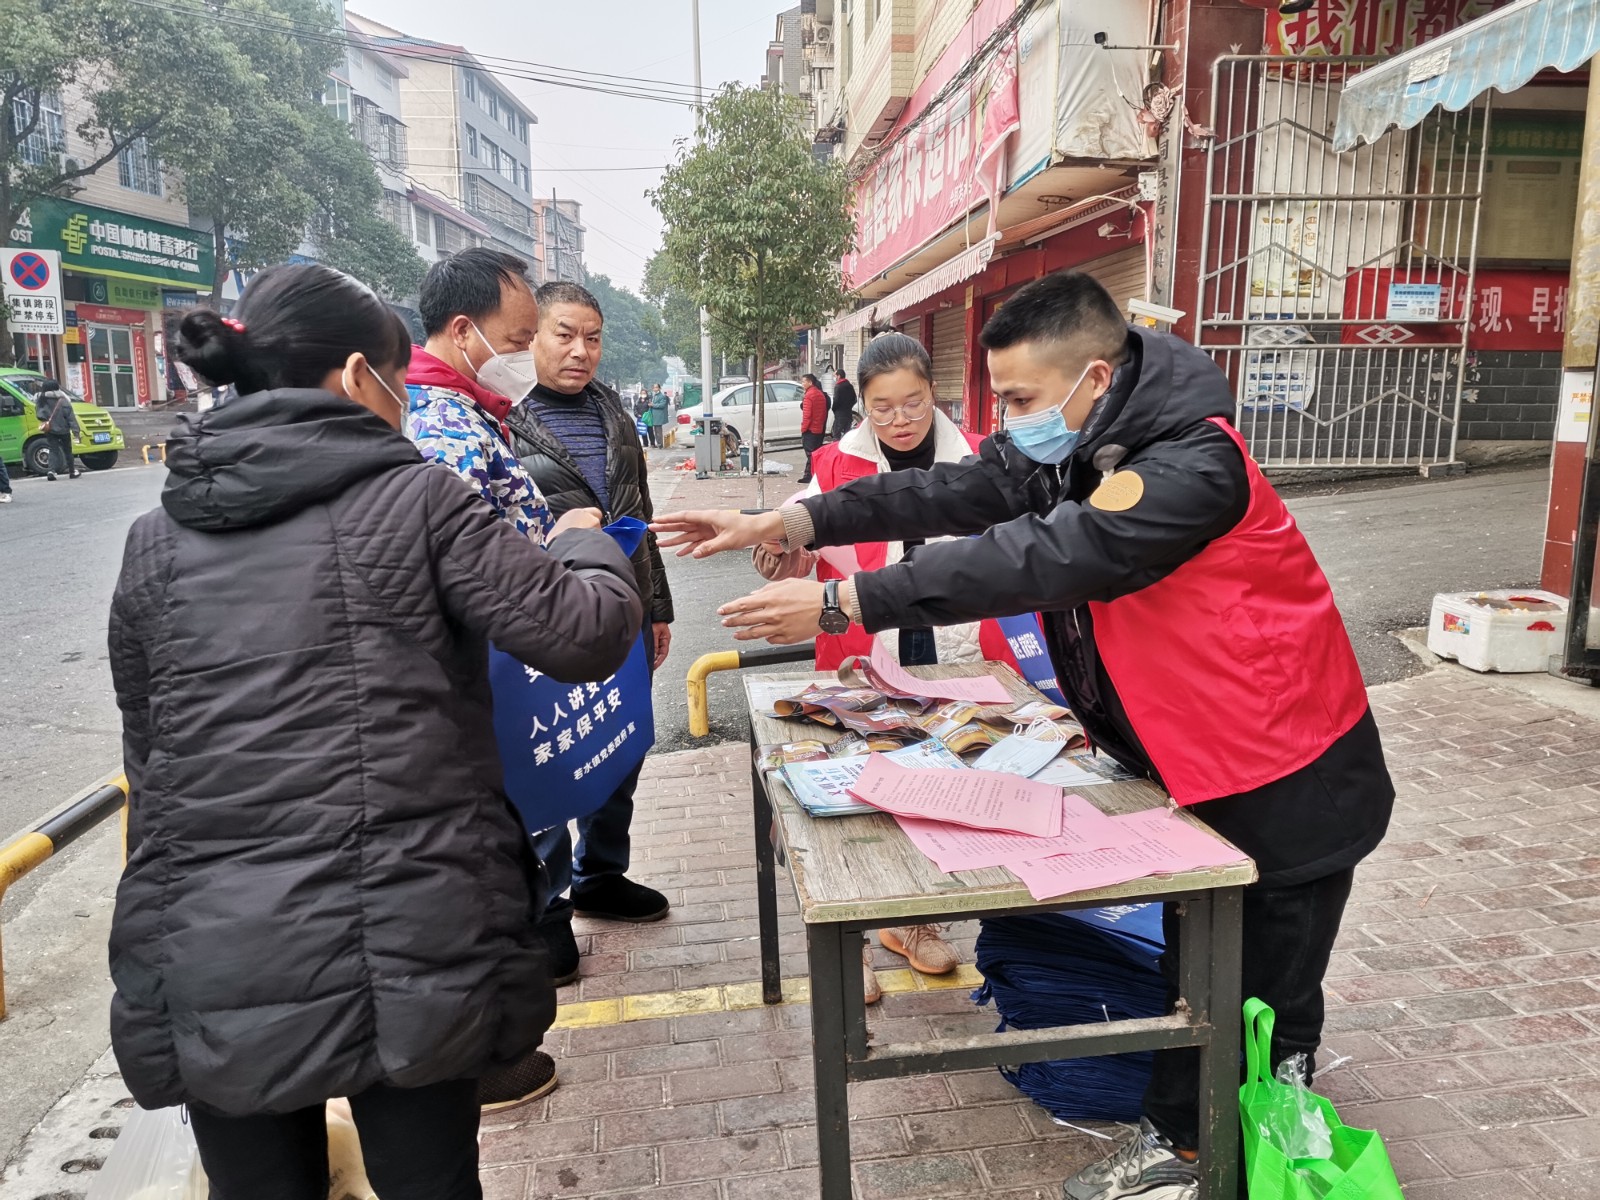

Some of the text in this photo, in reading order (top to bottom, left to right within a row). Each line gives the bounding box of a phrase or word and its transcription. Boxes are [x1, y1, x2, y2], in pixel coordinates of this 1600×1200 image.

[10, 228, 33, 243] OST
[90, 219, 199, 260] 中国邮政储蓄银行
[90, 245, 121, 259] POSTAL
[12, 298, 54, 309] 集镇路段
[13, 311, 55, 321] 严禁停车
[529, 673, 616, 739] 人人讲安
[533, 687, 622, 766] 家家保平安
